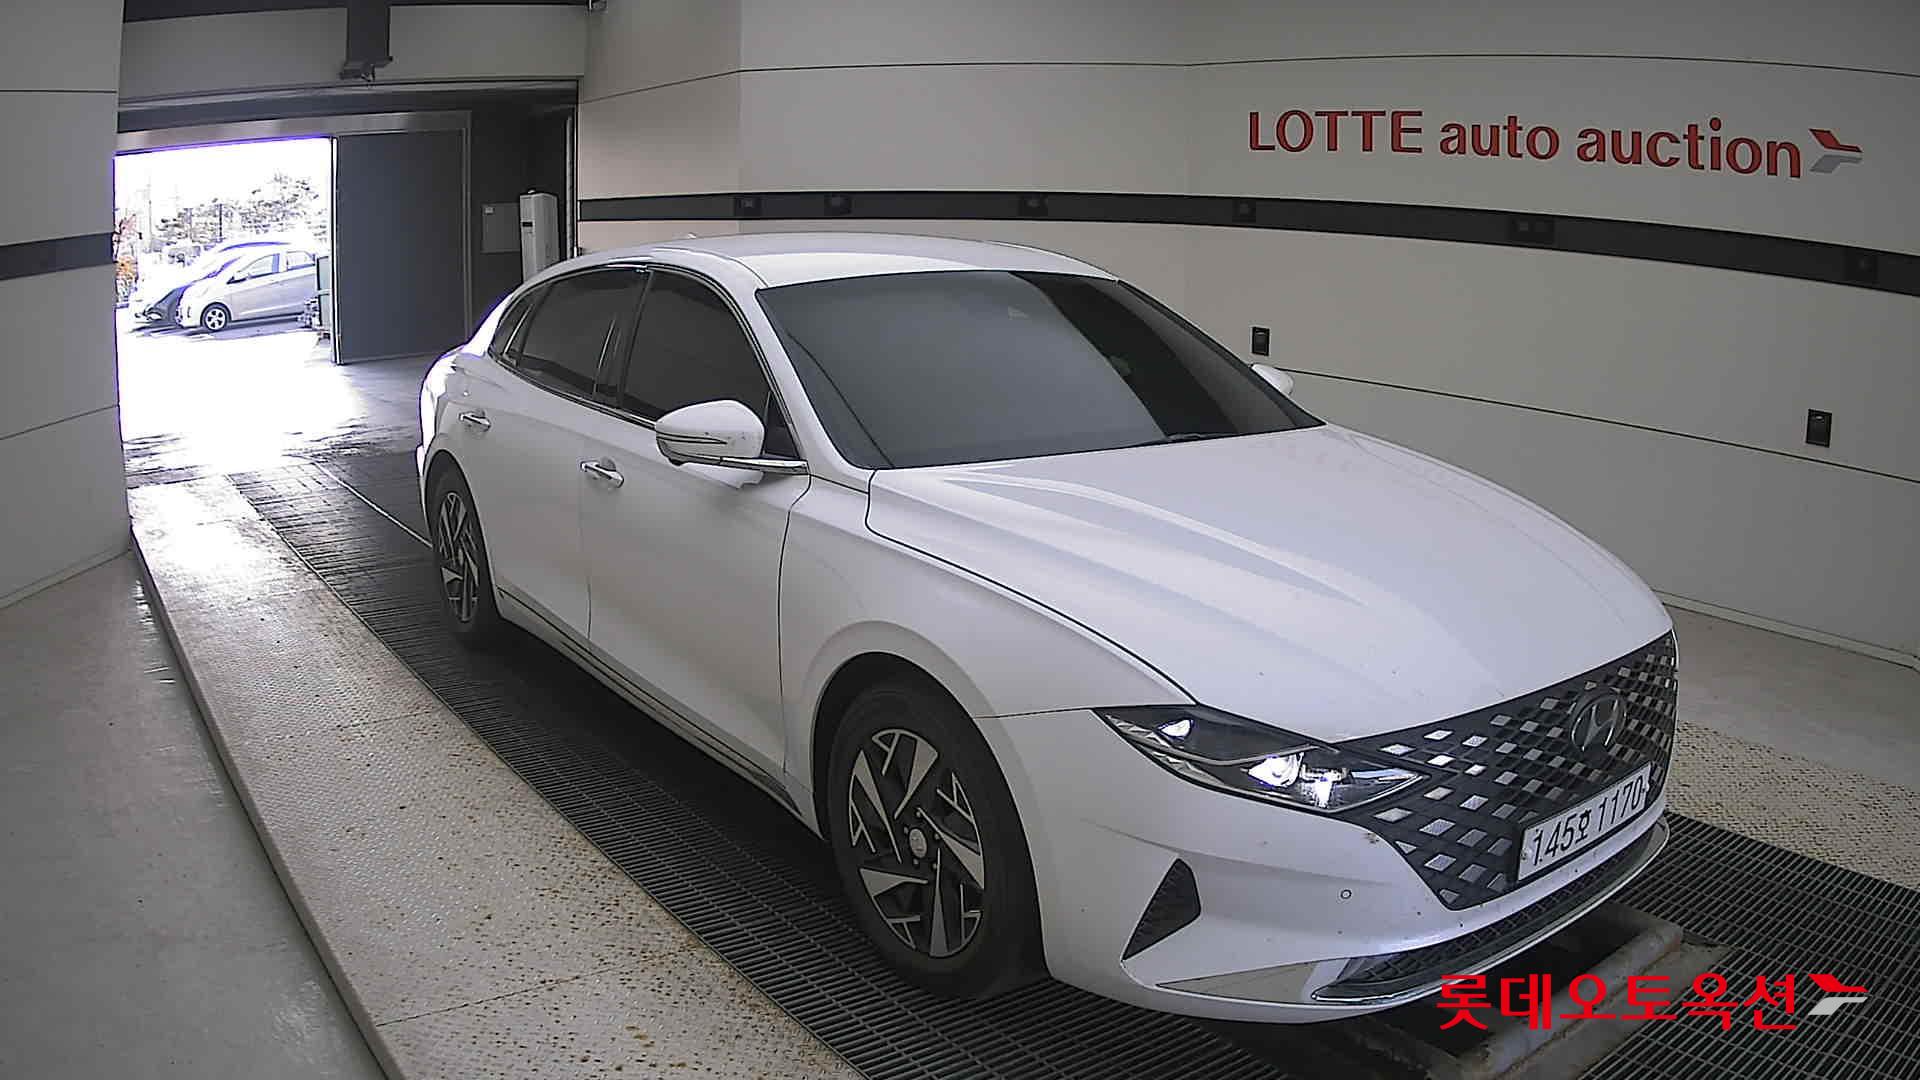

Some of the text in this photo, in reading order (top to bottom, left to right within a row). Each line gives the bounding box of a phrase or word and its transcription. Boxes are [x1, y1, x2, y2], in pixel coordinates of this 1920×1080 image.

[1249, 110, 1802, 178] LOTTE auto auction
[1598, 775, 1644, 832] 1170
